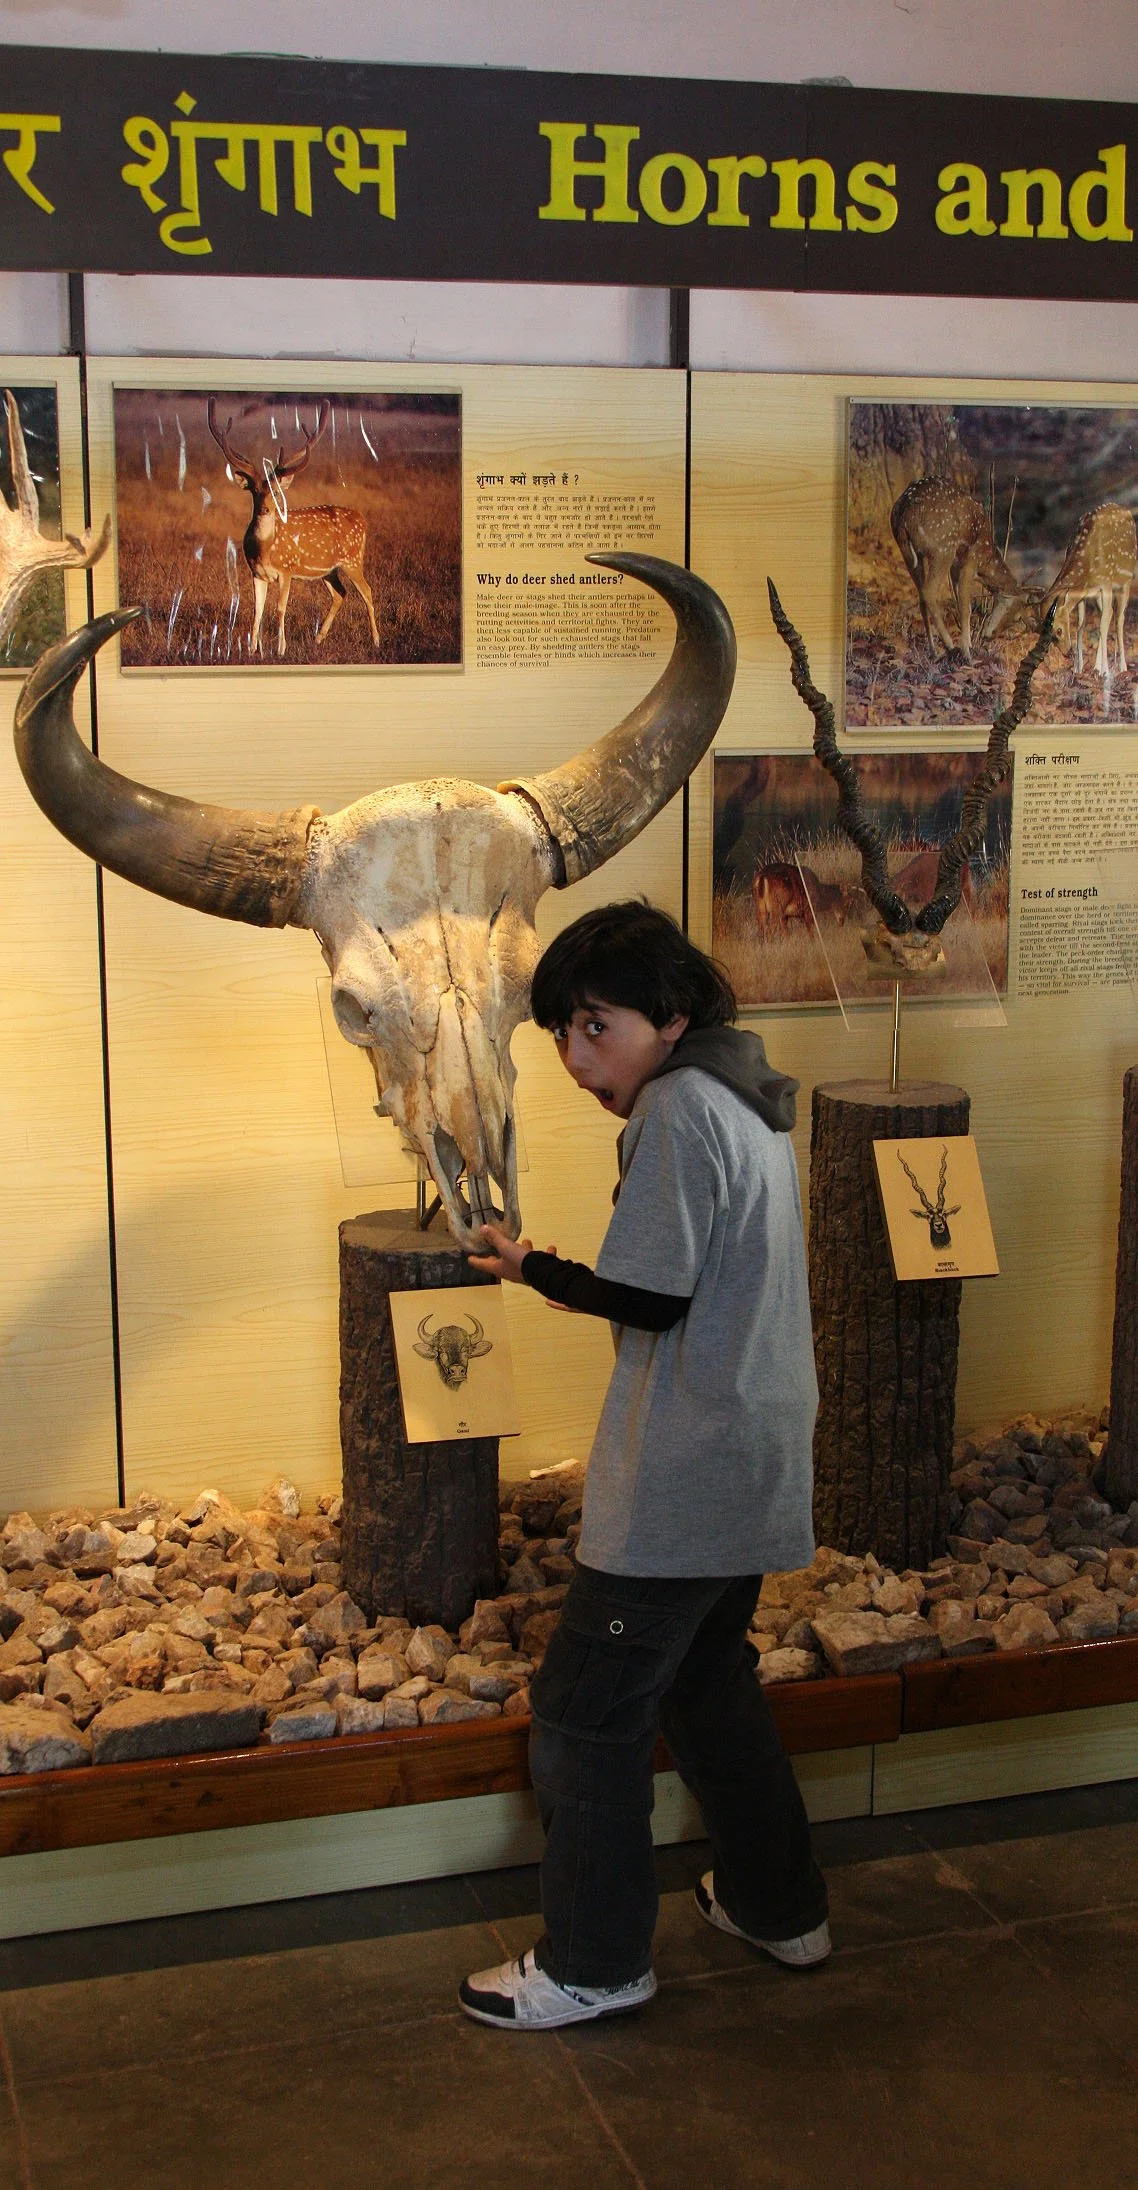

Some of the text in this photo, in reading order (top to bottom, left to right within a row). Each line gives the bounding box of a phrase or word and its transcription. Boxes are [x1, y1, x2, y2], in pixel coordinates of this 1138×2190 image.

[121, 91, 406, 255] शृंगाभ
[538, 121, 1133, 243] Horns and
[476, 473, 504, 489] शृंगाभ
[510, 473, 526, 485] क्यों
[533, 474, 556, 487] झड़ते
[575, 475, 579, 485] ?
[477, 574, 624, 588] Why do deer shed antlers?
[617, 593, 645, 601] perhaps
[514, 602, 559, 610] male-image.
[477, 611, 509, 619] breeding
[563, 610, 578, 618] they
[636, 610, 645, 618] by
[476, 619, 502, 627] rutting
[622, 618, 640, 626] They
[513, 627, 541, 635] capable
[601, 635, 620, 643] stags
[543, 643, 576, 651] shedding
[621, 643, 640, 651] stags
[1025, 753, 1079, 765] शक्ति परीक्षण
[1021, 887, 1098, 899] Test of strength
